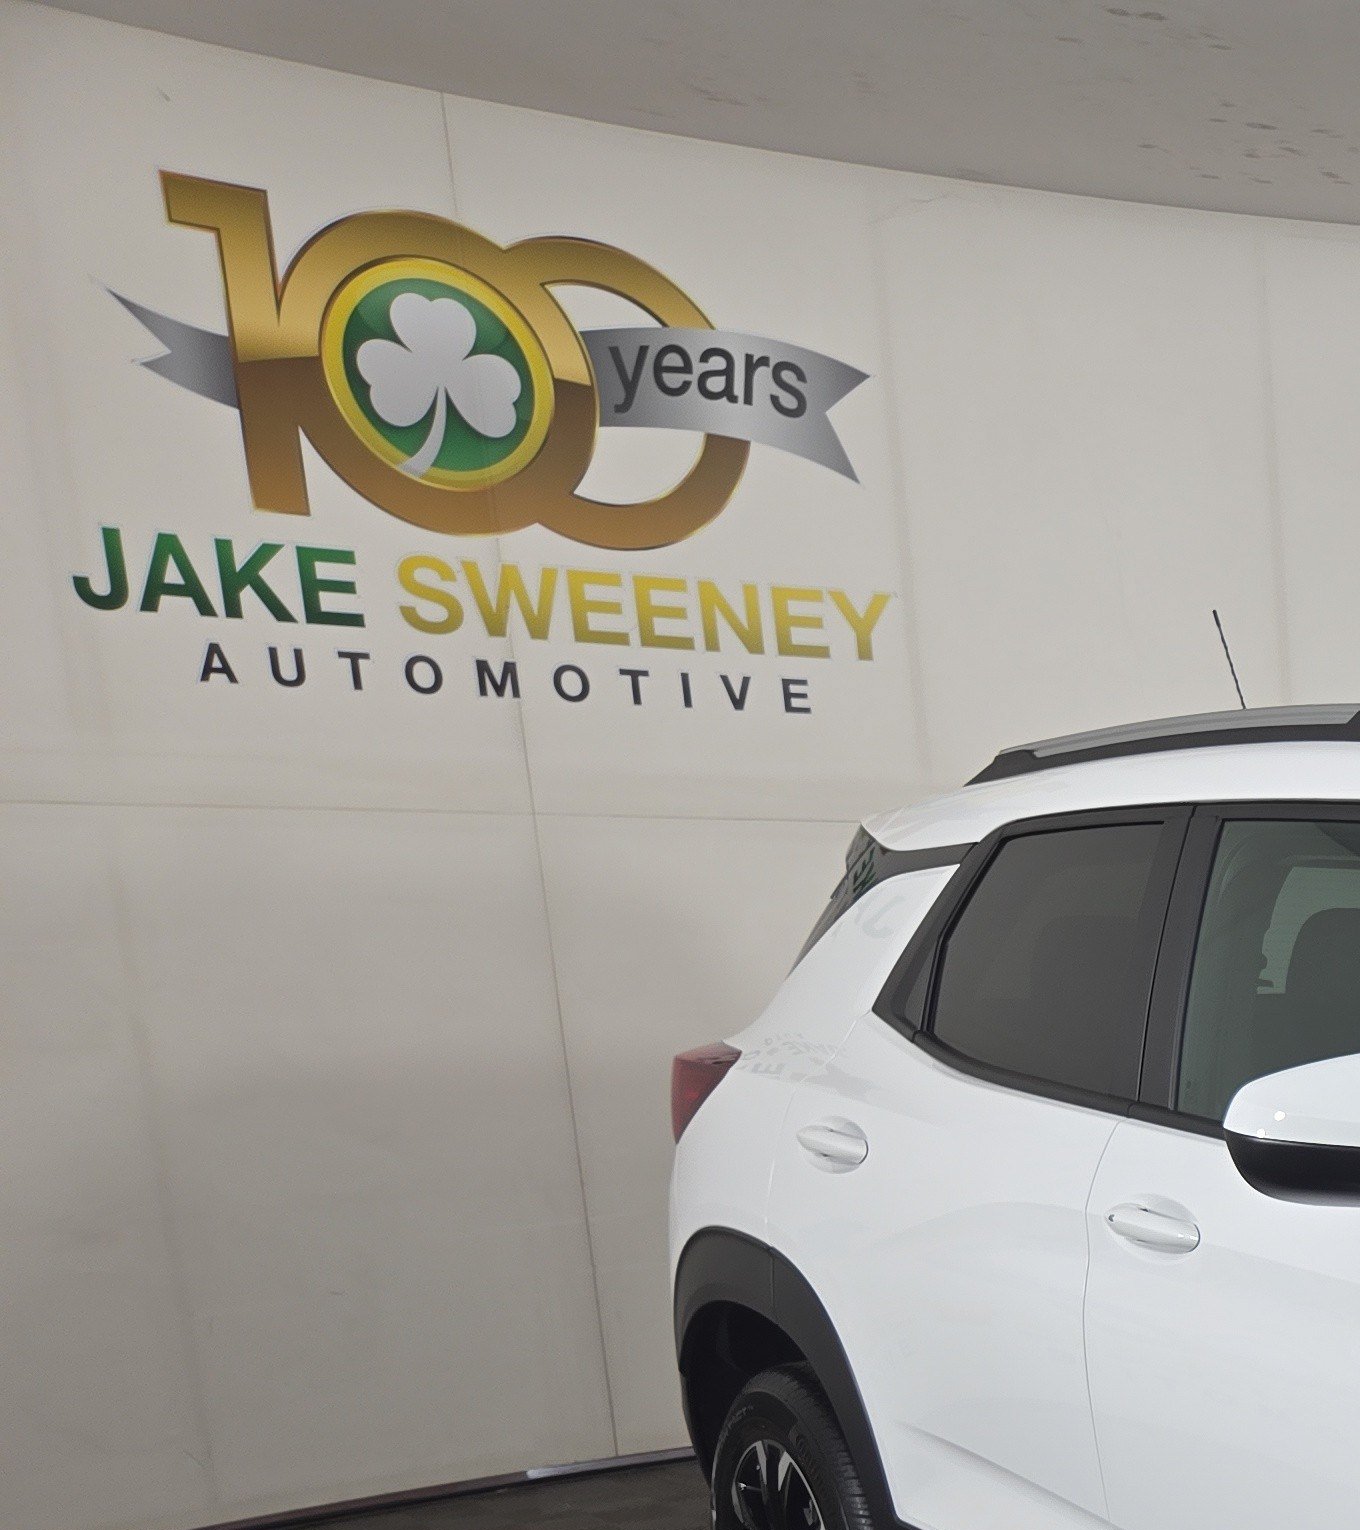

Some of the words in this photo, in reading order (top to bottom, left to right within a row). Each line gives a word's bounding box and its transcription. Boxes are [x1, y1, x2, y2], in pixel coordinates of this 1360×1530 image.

[608, 335, 810, 419] years
[72, 526, 366, 628] JAKE
[398, 554, 892, 662] SWEENEY
[199, 641, 813, 715] AUTOMOTIVE
